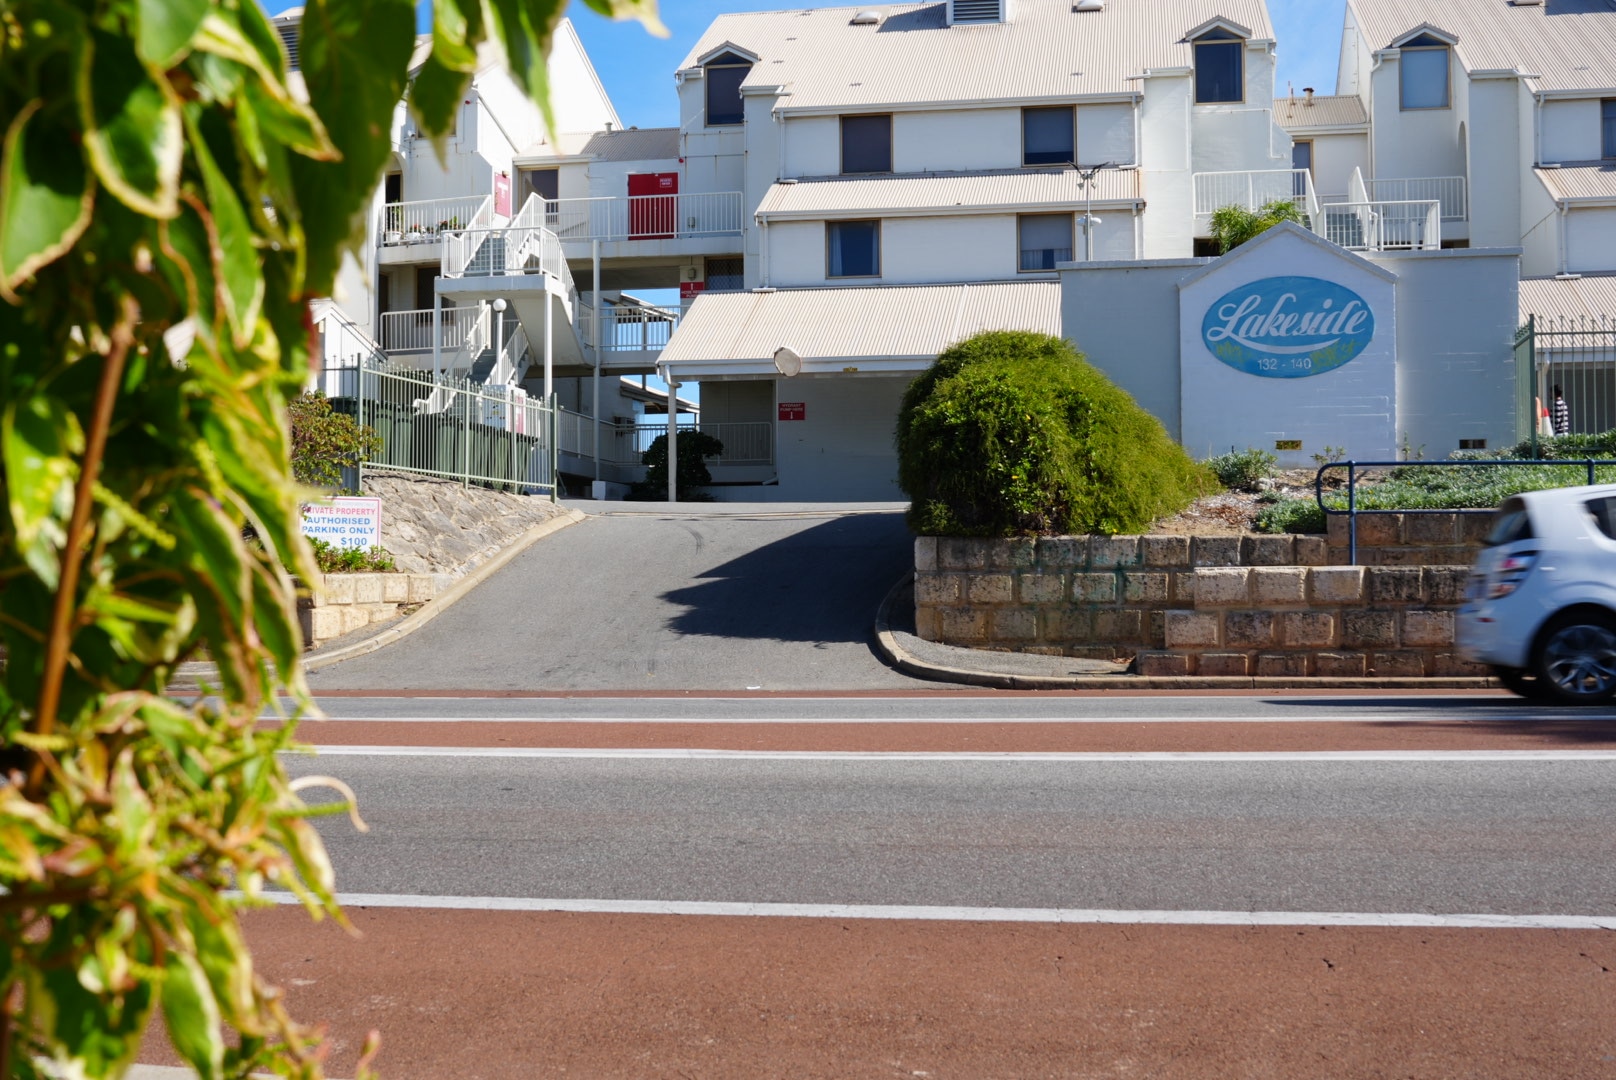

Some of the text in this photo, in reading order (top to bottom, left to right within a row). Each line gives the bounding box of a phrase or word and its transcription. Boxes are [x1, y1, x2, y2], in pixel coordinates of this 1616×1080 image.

[1206, 293, 1368, 342] Lakeside
[1257, 358, 1278, 371] 132
[1290, 358, 1312, 370] 140
